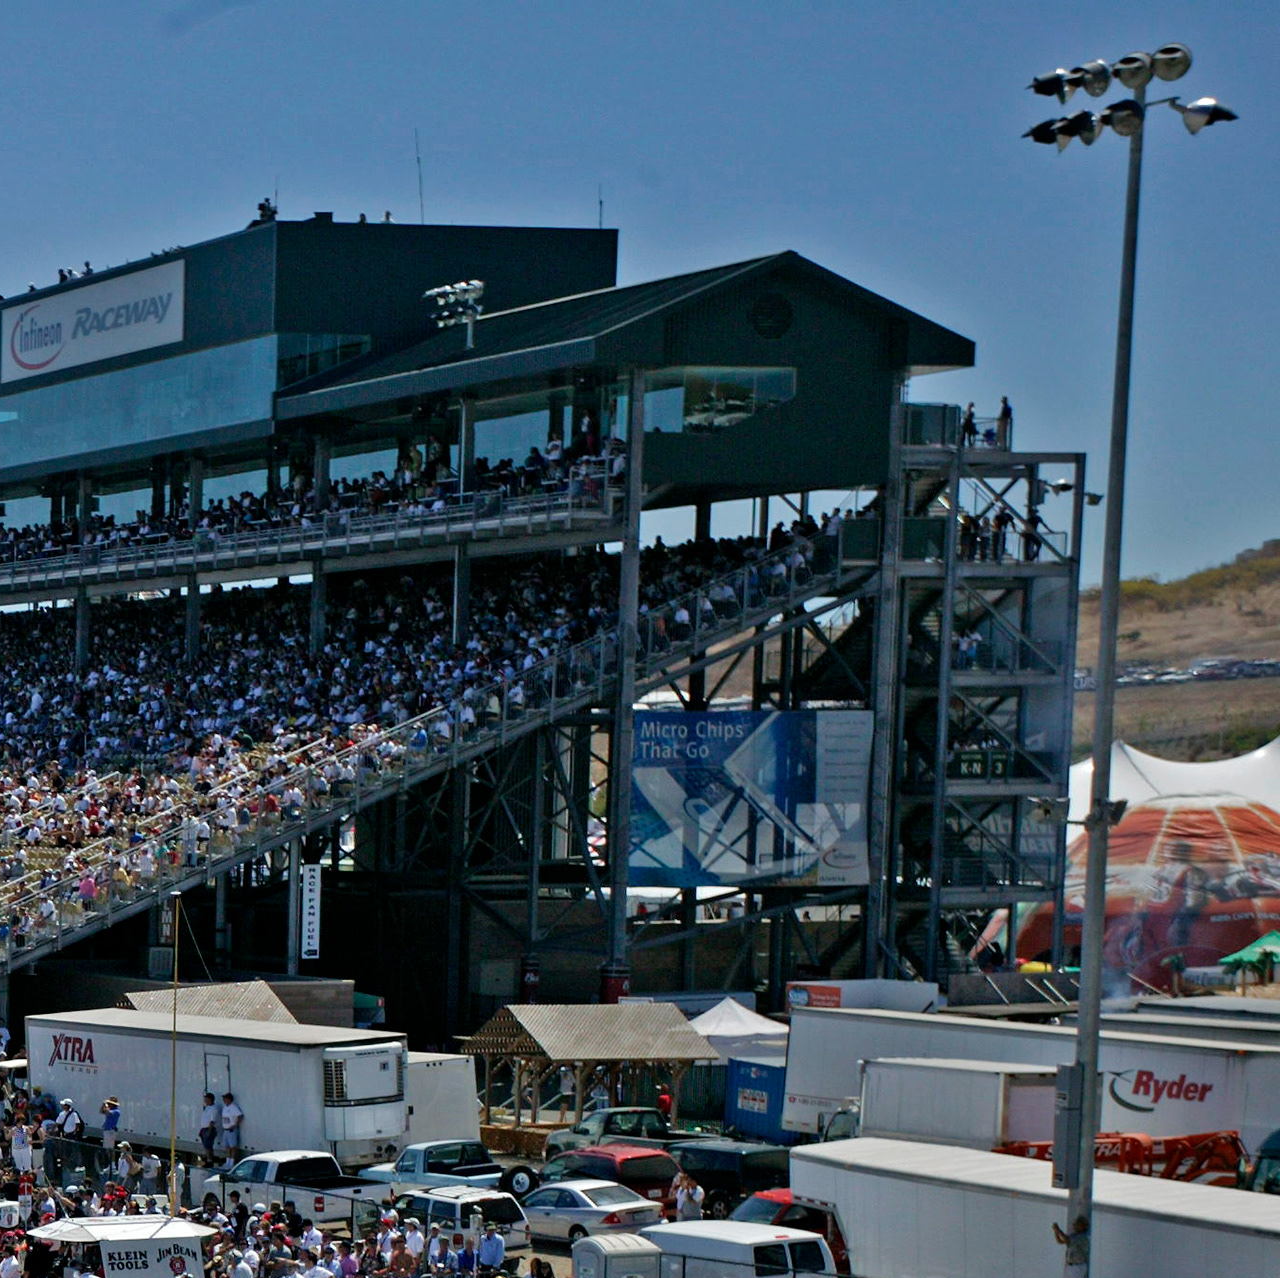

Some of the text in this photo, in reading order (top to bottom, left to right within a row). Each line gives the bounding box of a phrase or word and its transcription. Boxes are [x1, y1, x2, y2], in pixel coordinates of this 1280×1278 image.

[19, 293, 173, 353] Infineon RACEWAY
[640, 720, 744, 741] Micro Chips
[640, 742, 710, 759] That Go
[48, 1033, 95, 1067] XTRA
[1132, 1069, 1214, 1104] Ryder
[107, 1250, 148, 1262] KLEIN
[156, 1243, 198, 1263] JIM BEAM
[107, 1260, 149, 1271] TOOLS
